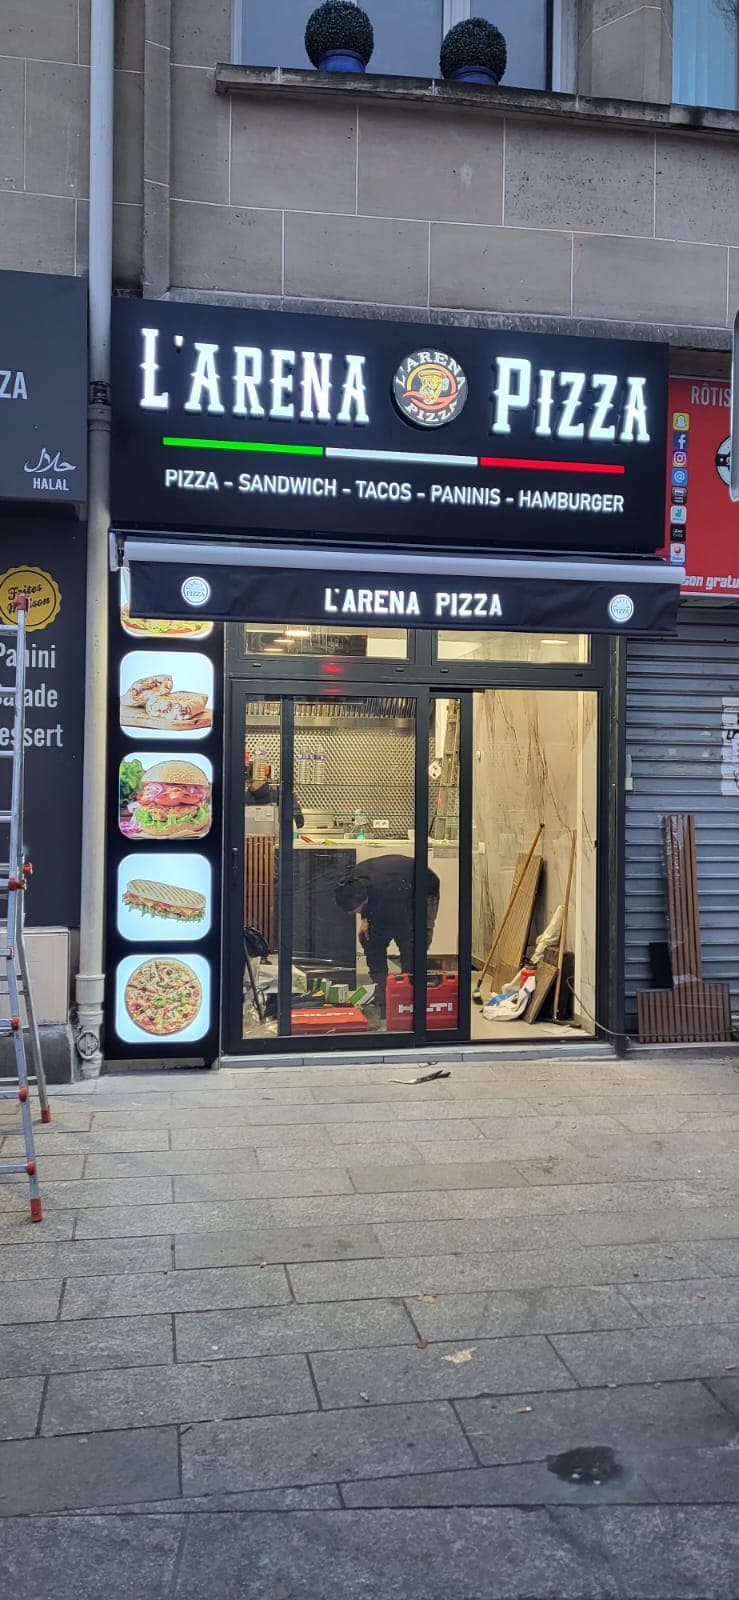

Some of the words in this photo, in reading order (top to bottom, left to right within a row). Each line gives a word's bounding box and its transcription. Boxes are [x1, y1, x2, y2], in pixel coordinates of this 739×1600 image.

[139, 327, 370, 425] L'ARENA
[492, 356, 651, 443] PIZZA
[395, 351, 466, 389] L'ARENA
[24, 447, 77, 473] حلال
[32, 477, 70, 491] HALAL
[164, 468, 220, 491] PIZZA
[237, 473, 338, 497] SANDWICH
[355, 480, 412, 502] TACOS
[430, 484, 501, 507] PANINIS
[518, 489, 625, 513] HAMBURGER
[6, 596, 51, 615] Mison
[324, 587, 421, 616] L'ARENA
[435, 592, 503, 617] PIZZA
